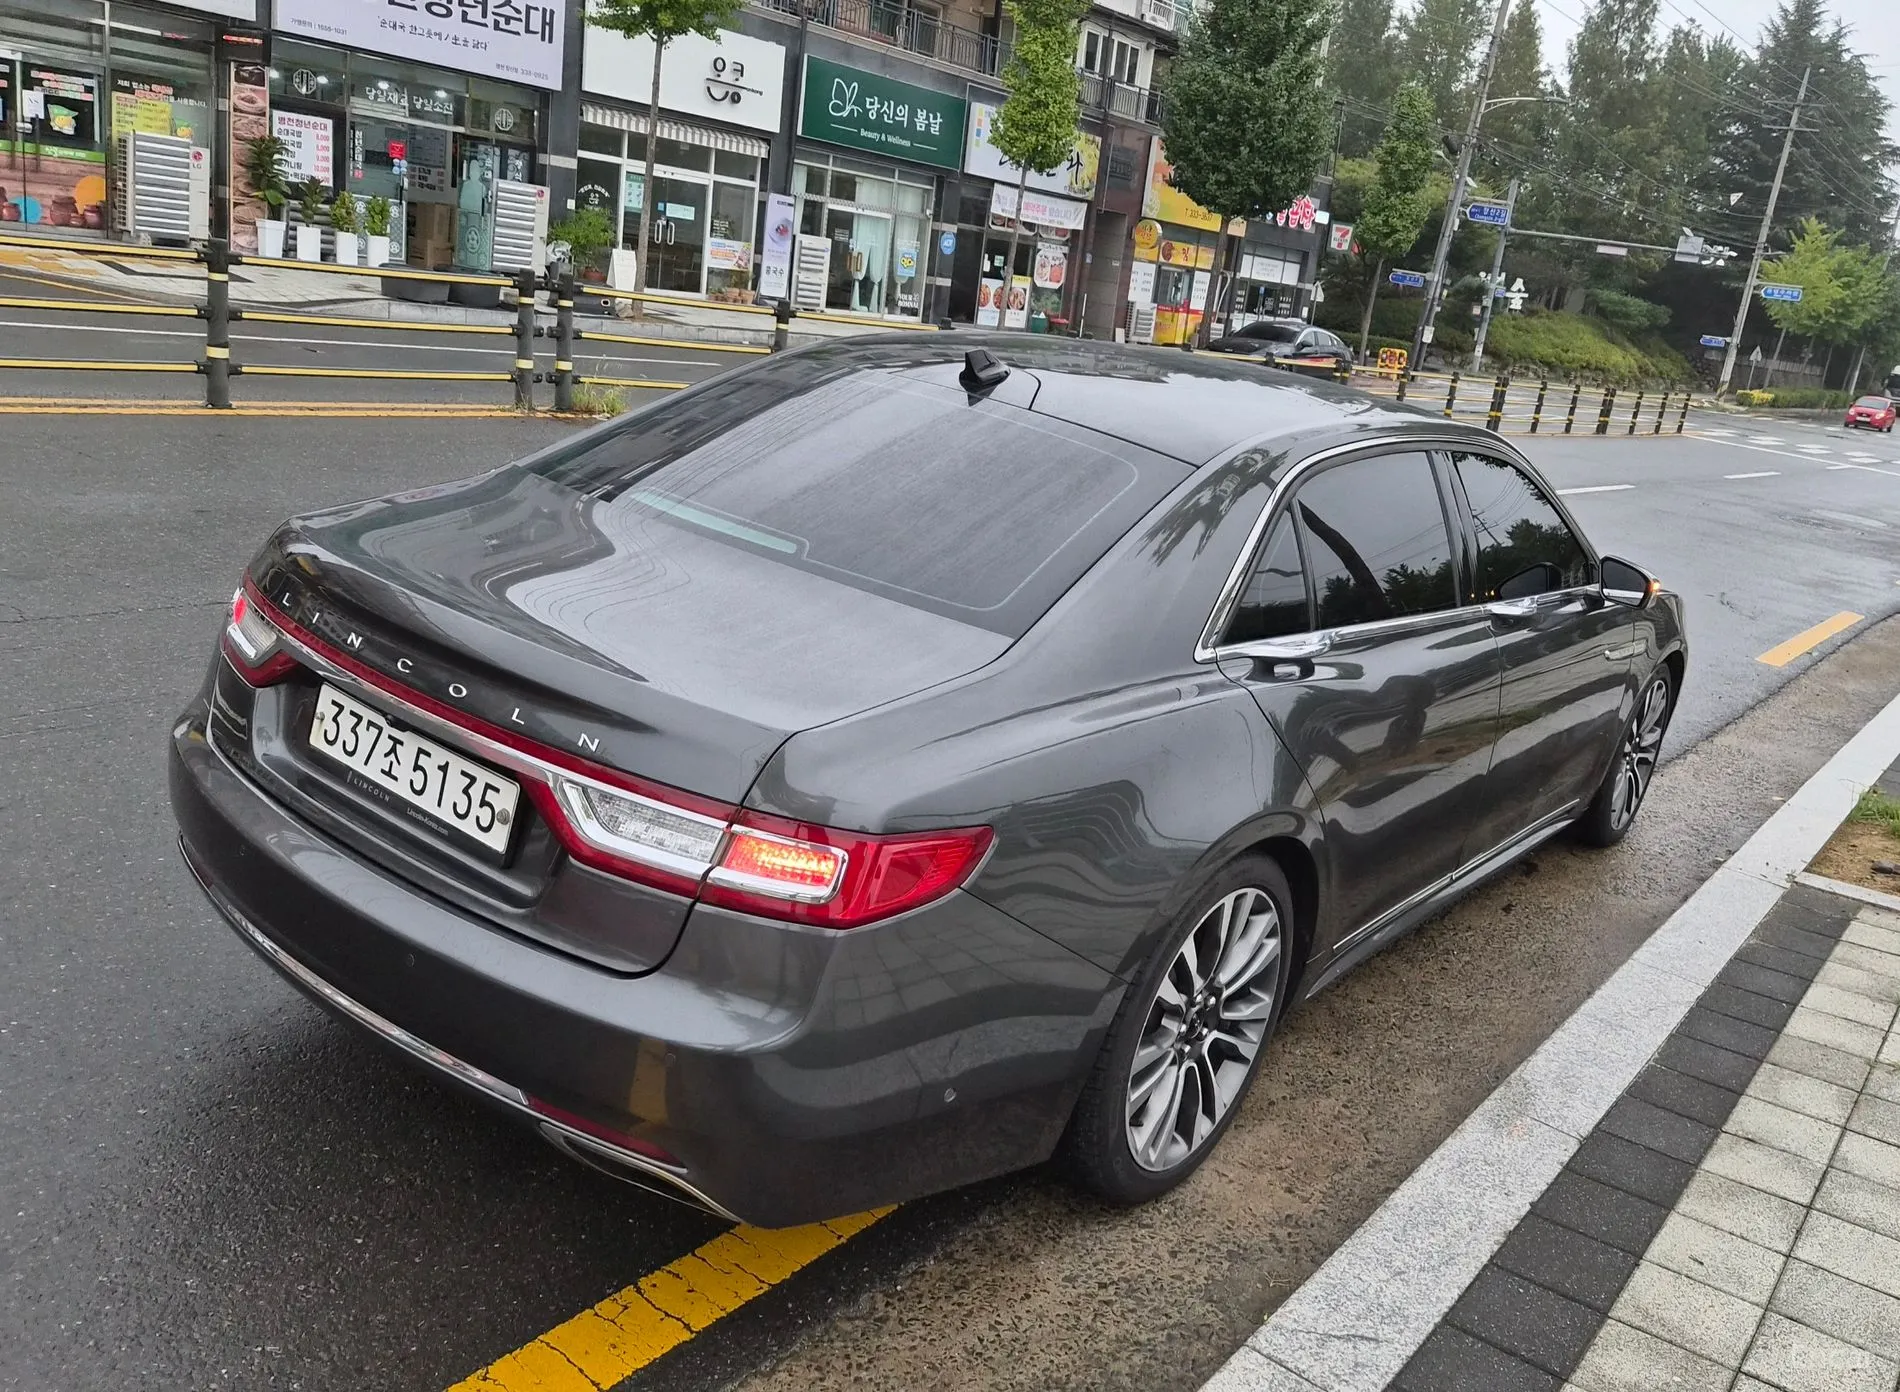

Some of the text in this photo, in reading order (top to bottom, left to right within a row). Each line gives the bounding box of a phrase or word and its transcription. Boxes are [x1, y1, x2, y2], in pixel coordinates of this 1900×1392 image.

[387, 0, 556, 44] 년순대
[413, 95, 453, 115] 당일소진
[865, 95, 943, 136] 당신의 봄날
[860, 128, 881, 142] Beauty
[886, 133, 911, 148] Wellness
[281, 591, 601, 753] LINCOLN
[353, 777, 391, 802] LINCOLN
